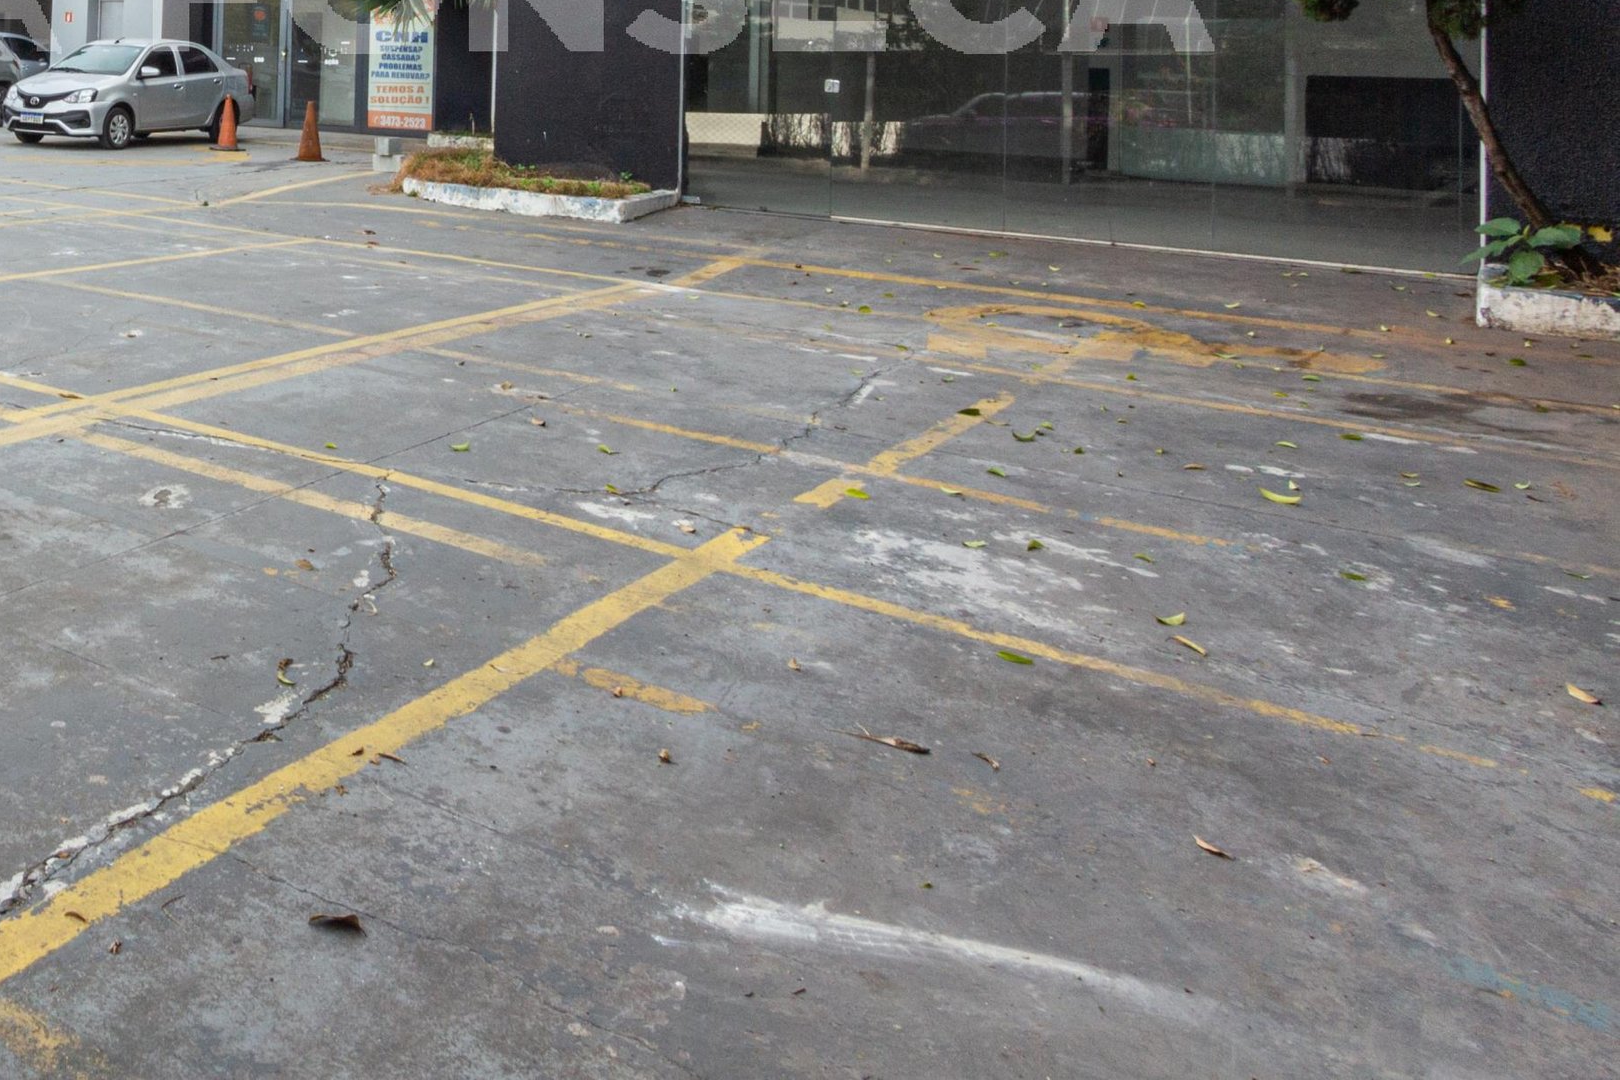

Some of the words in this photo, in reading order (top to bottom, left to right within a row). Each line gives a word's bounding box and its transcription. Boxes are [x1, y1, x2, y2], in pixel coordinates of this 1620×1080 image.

[379, 62, 423, 71] PROBLEMAS
[371, 70, 389, 78] PARA
[376, 85, 414, 94] TEMOS
[416, 85, 425, 94] A
[370, 94, 422, 105] SOLUÇÃO
